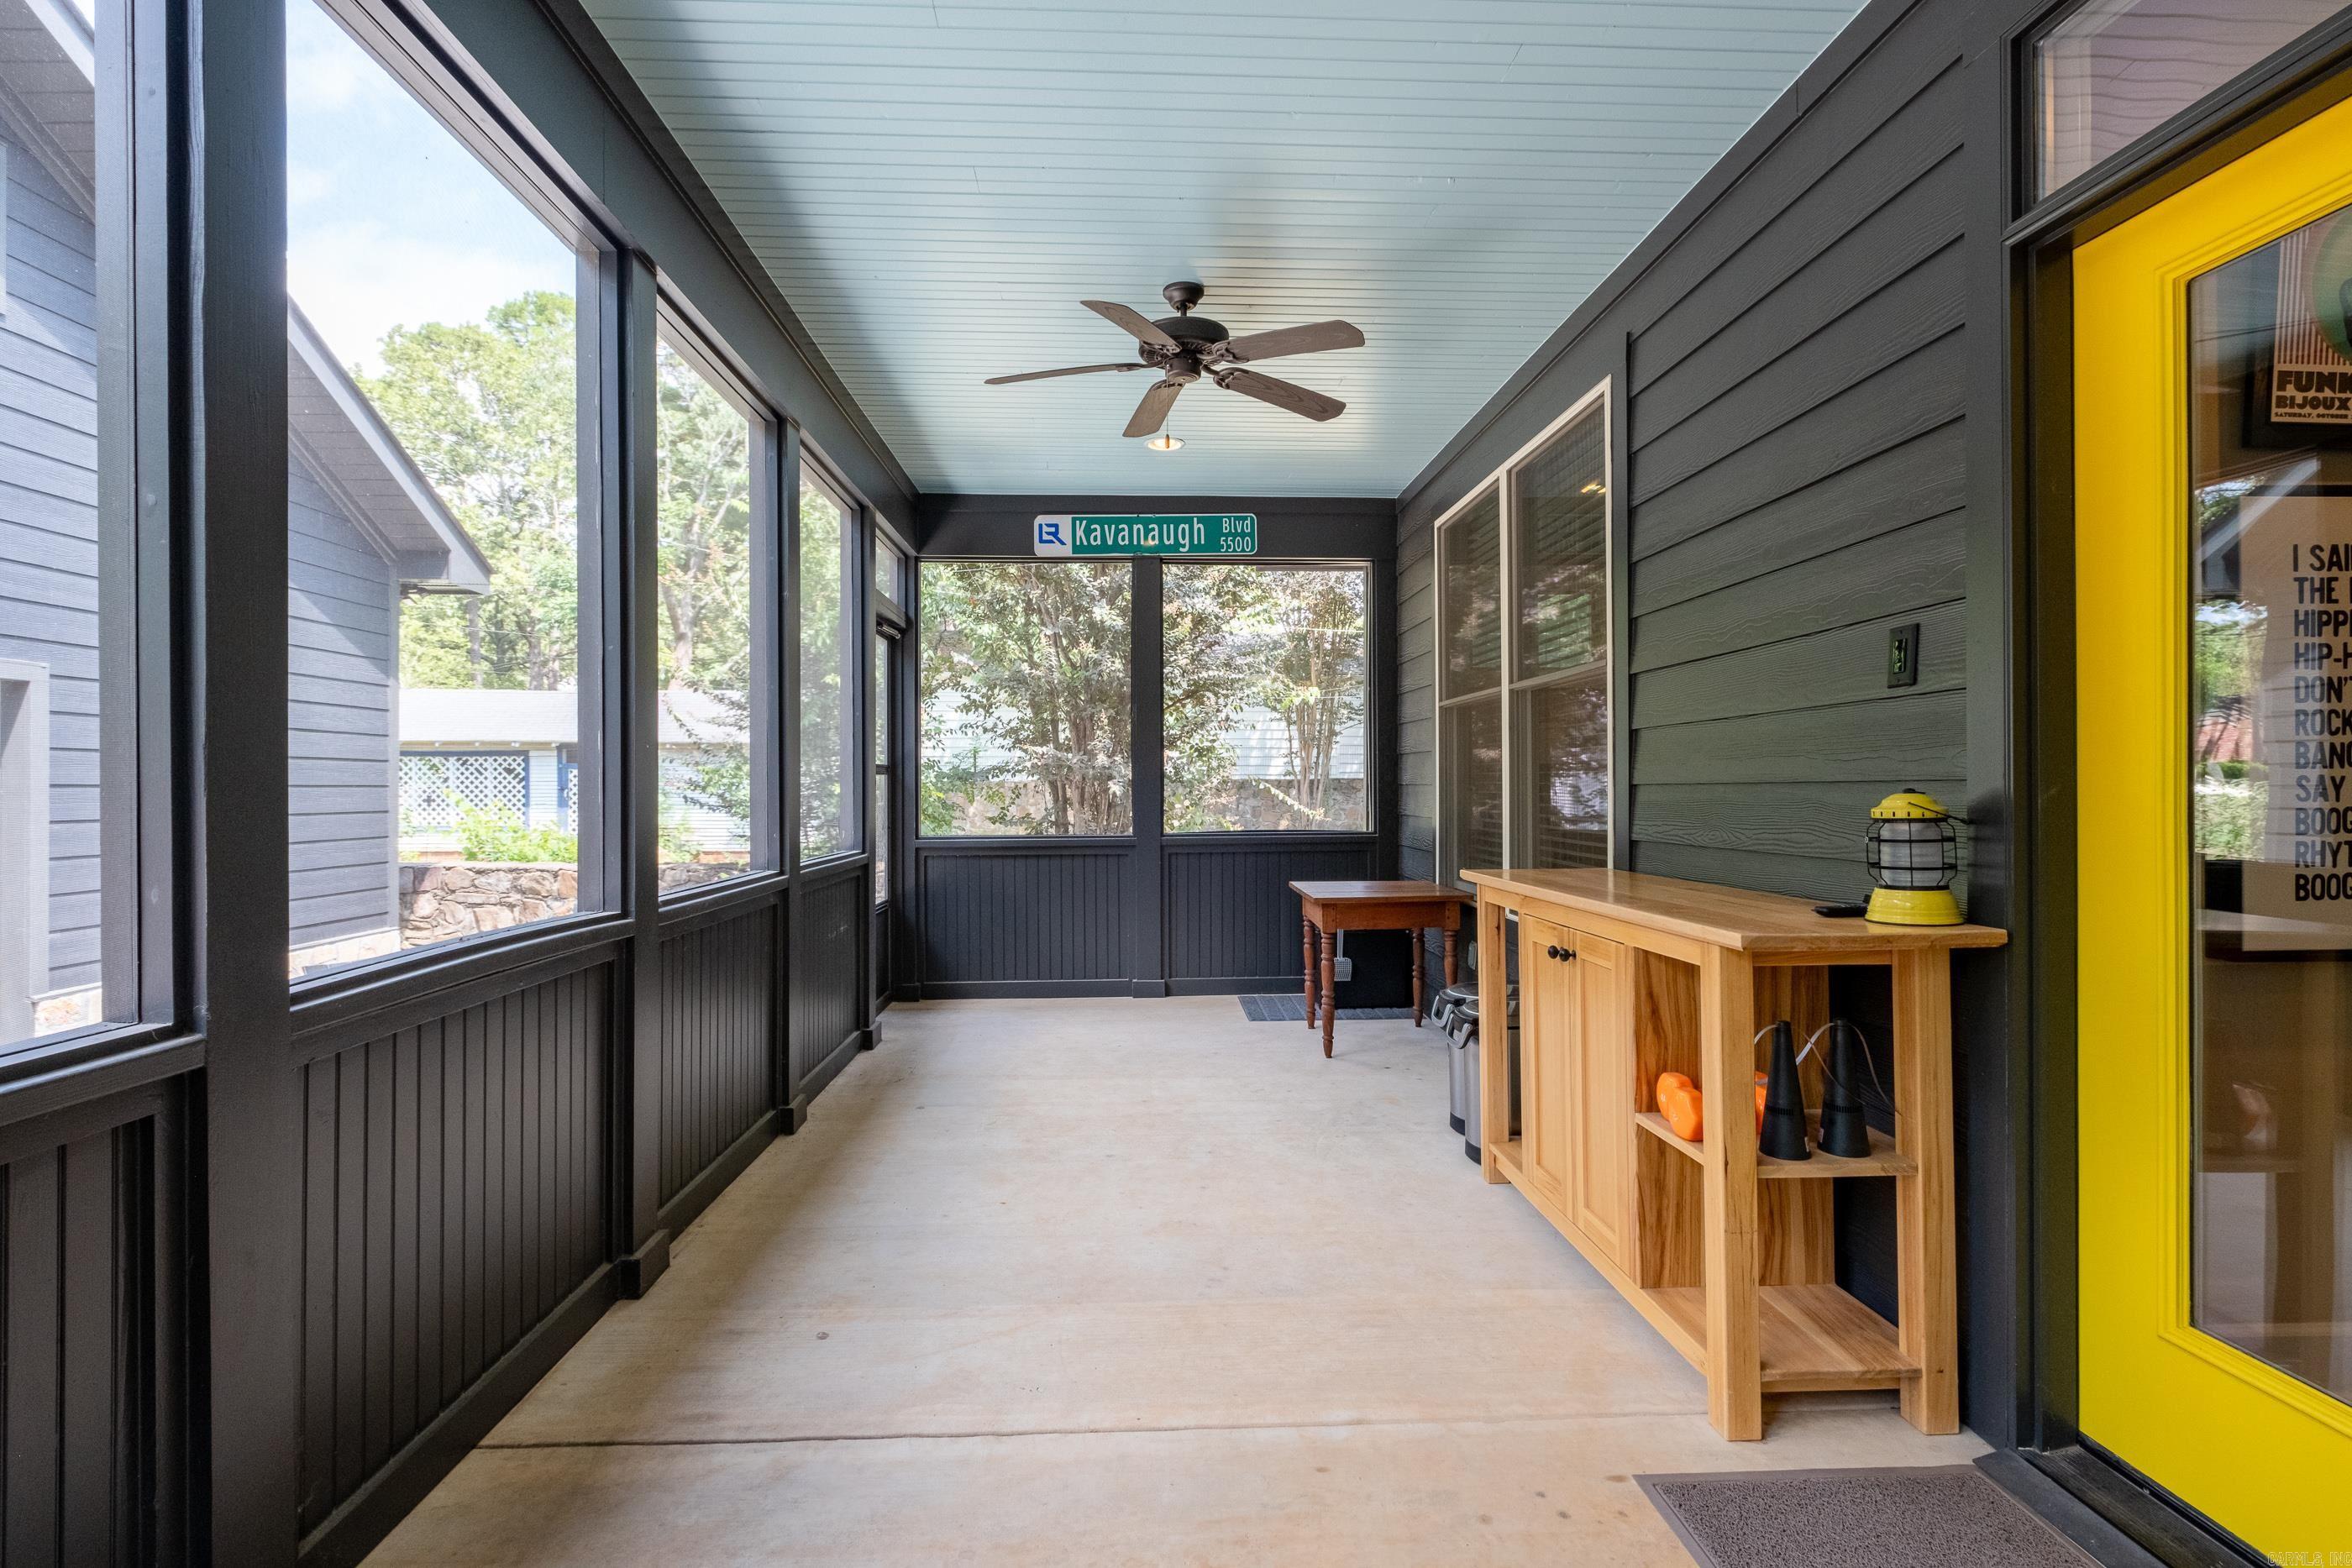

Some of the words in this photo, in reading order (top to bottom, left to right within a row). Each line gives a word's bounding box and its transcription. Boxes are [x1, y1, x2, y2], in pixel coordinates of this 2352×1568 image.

[2275, 395, 2352, 411] BIJOUX
[1075, 517, 1205, 552] Kavanaugh
[1222, 517, 1251, 533] Blvd
[1220, 537, 1252, 552] 5500
[2293, 544, 2298, 572] I
[2310, 543, 2352, 572] SAI
[2293, 577, 2339, 604] THE
[2295, 774, 2346, 803] SAY
